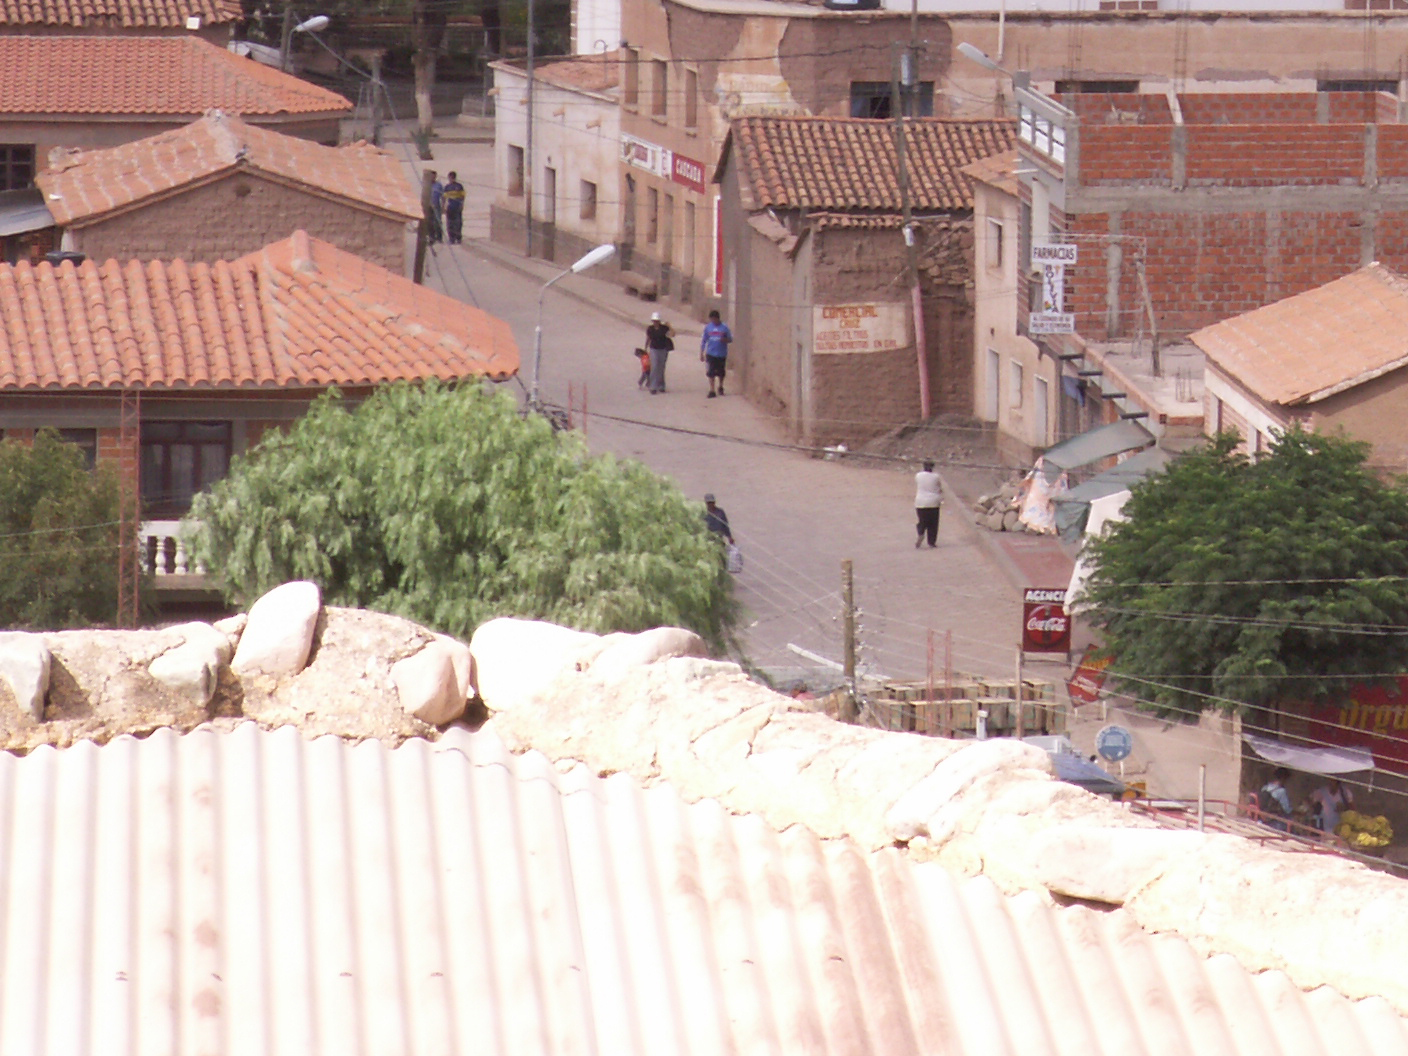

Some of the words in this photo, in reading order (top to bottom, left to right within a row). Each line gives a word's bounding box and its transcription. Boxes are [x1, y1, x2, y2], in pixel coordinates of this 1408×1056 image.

[1033, 247, 1075, 260] FARMACIAS
[1045, 264, 1060, 313] BOLIVIA
[822, 306, 878, 319] COMERCIAL
[1025, 590, 1067, 602] AGENCI
